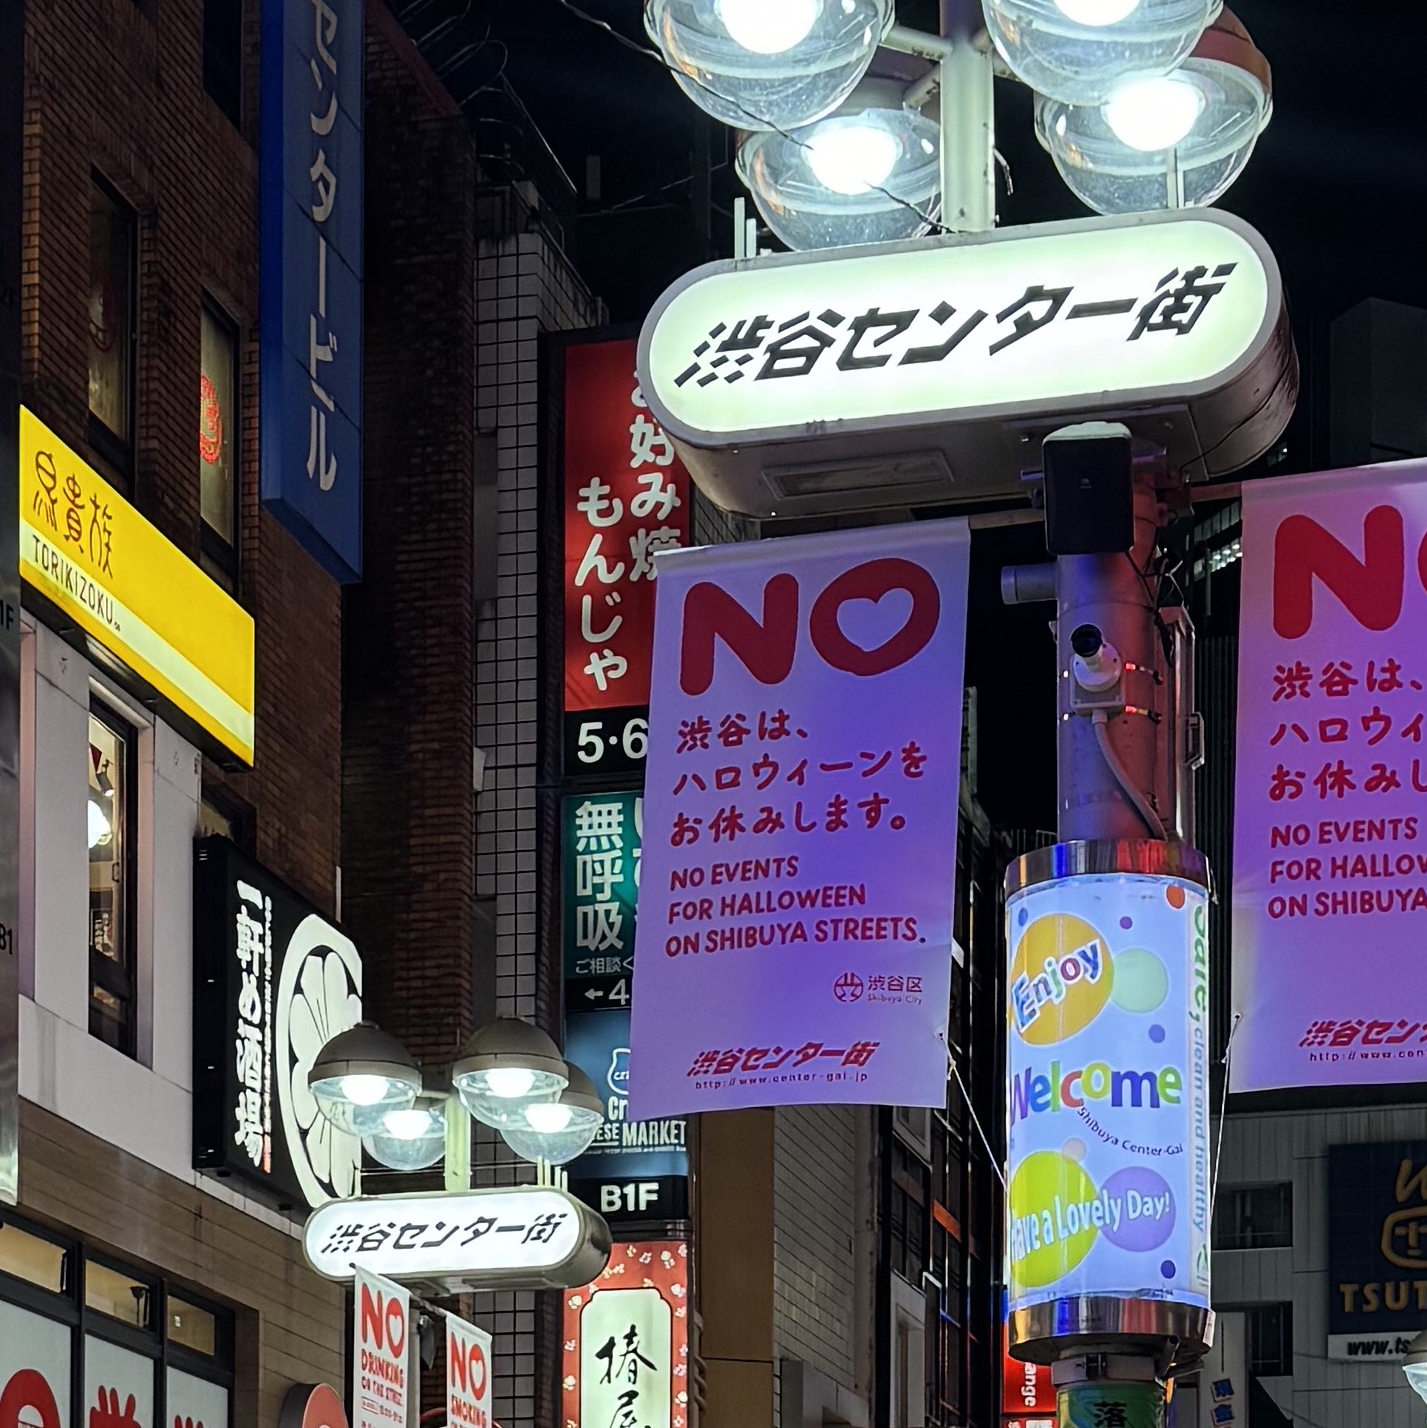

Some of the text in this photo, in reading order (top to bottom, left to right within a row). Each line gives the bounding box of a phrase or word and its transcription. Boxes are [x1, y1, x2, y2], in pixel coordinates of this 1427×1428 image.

[674, 260, 1239, 389] 渋谷センター街
[32, 533, 114, 626] TORIKIZOKU
[575, 478, 628, 692] もんじゃ
[680, 556, 940, 696] NO
[1272, 657, 1424, 701] 渋谷は、
[676, 709, 809, 754] 渋谷は、
[673, 741, 928, 796] ハロウィーンを
[670, 792, 906, 847] お休みします。
[1271, 816, 1419, 849] NO EVENTS
[575, 802, 624, 951] 無呼吸
[671, 855, 799, 890] NO EVENTS
[1271, 858, 1322, 884] FOR
[669, 883, 866, 925] FOR HALLOWEEN
[1267, 892, 1307, 920] ON
[665, 916, 927, 958] ON SHIBUYA STREETS.
[868, 974, 922, 993] 渋谷区
[1012, 938, 1103, 1034] Enjoy
[685, 1040, 881, 1077] 渋谷センター街
[1010, 1061, 1183, 1127] Welcome
[622, 1120, 687, 1146] MARKET
[1077, 1105, 1119, 1147] Shibuya
[601, 1183, 659, 1214] B1F
[1041, 1190, 1170, 1242] a Lovely Day!
[321, 1212, 569, 1254] 渋谷センター街
[361, 1282, 405, 1359] NO
[450, 1331, 487, 1401] NO
